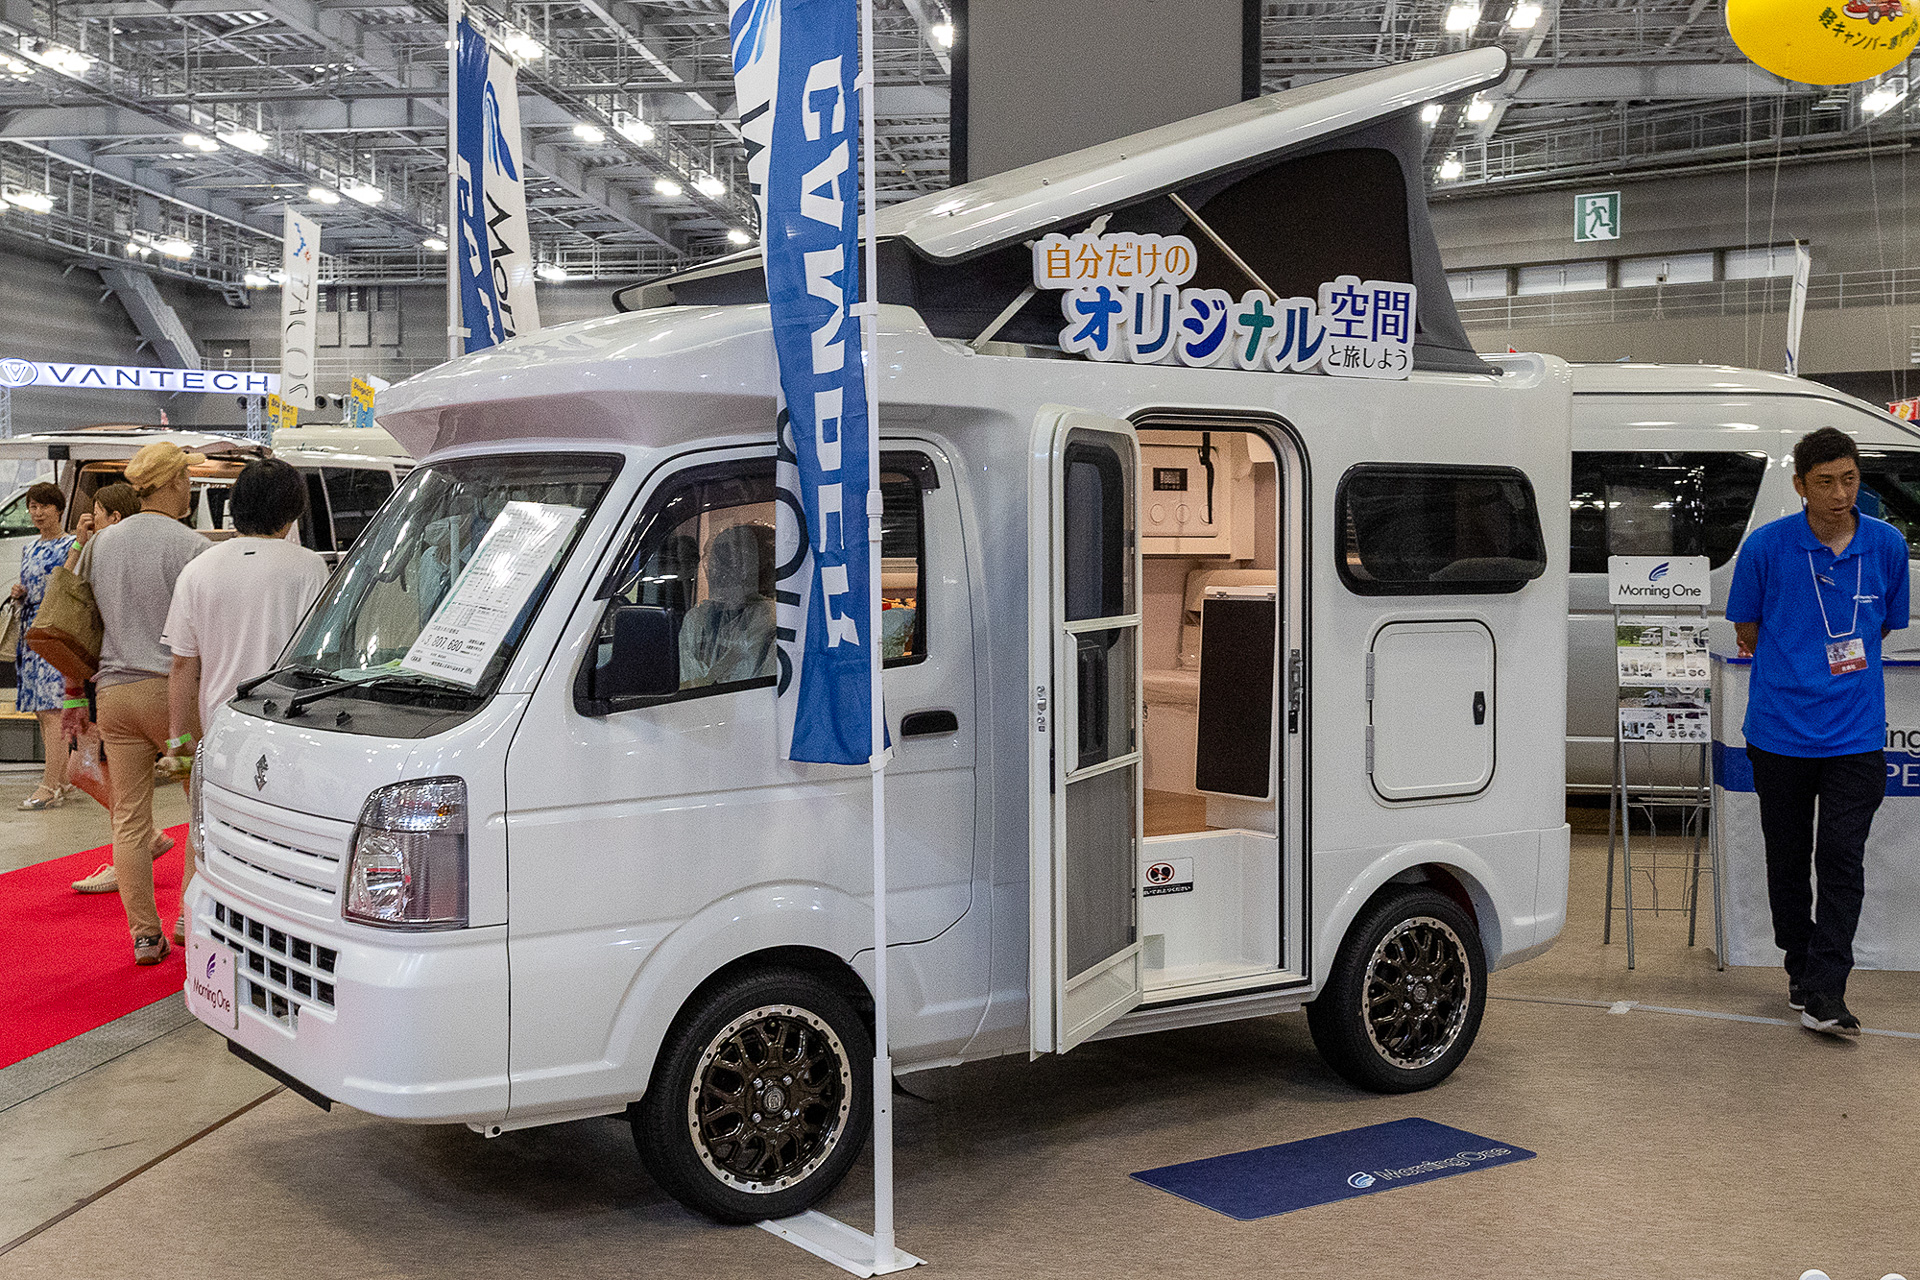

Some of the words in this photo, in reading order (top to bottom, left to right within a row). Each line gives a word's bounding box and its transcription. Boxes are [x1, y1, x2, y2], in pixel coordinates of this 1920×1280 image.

[1046, 241, 1191, 280] 自分だけの
[1073, 285, 1327, 364] オリジナル
[1329, 284, 1411, 345] 空間
[1327, 344, 1410, 372] と旅しよう
[48, 364, 269, 392] VANTECH
[1618, 584, 1670, 599] Morning
[1672, 584, 1702, 597] One
[193, 976, 217, 1009] Morning
[216, 989, 231, 1013] One
[1373, 1159, 1471, 1181] Morning
[1456, 1147, 1512, 1162] One
